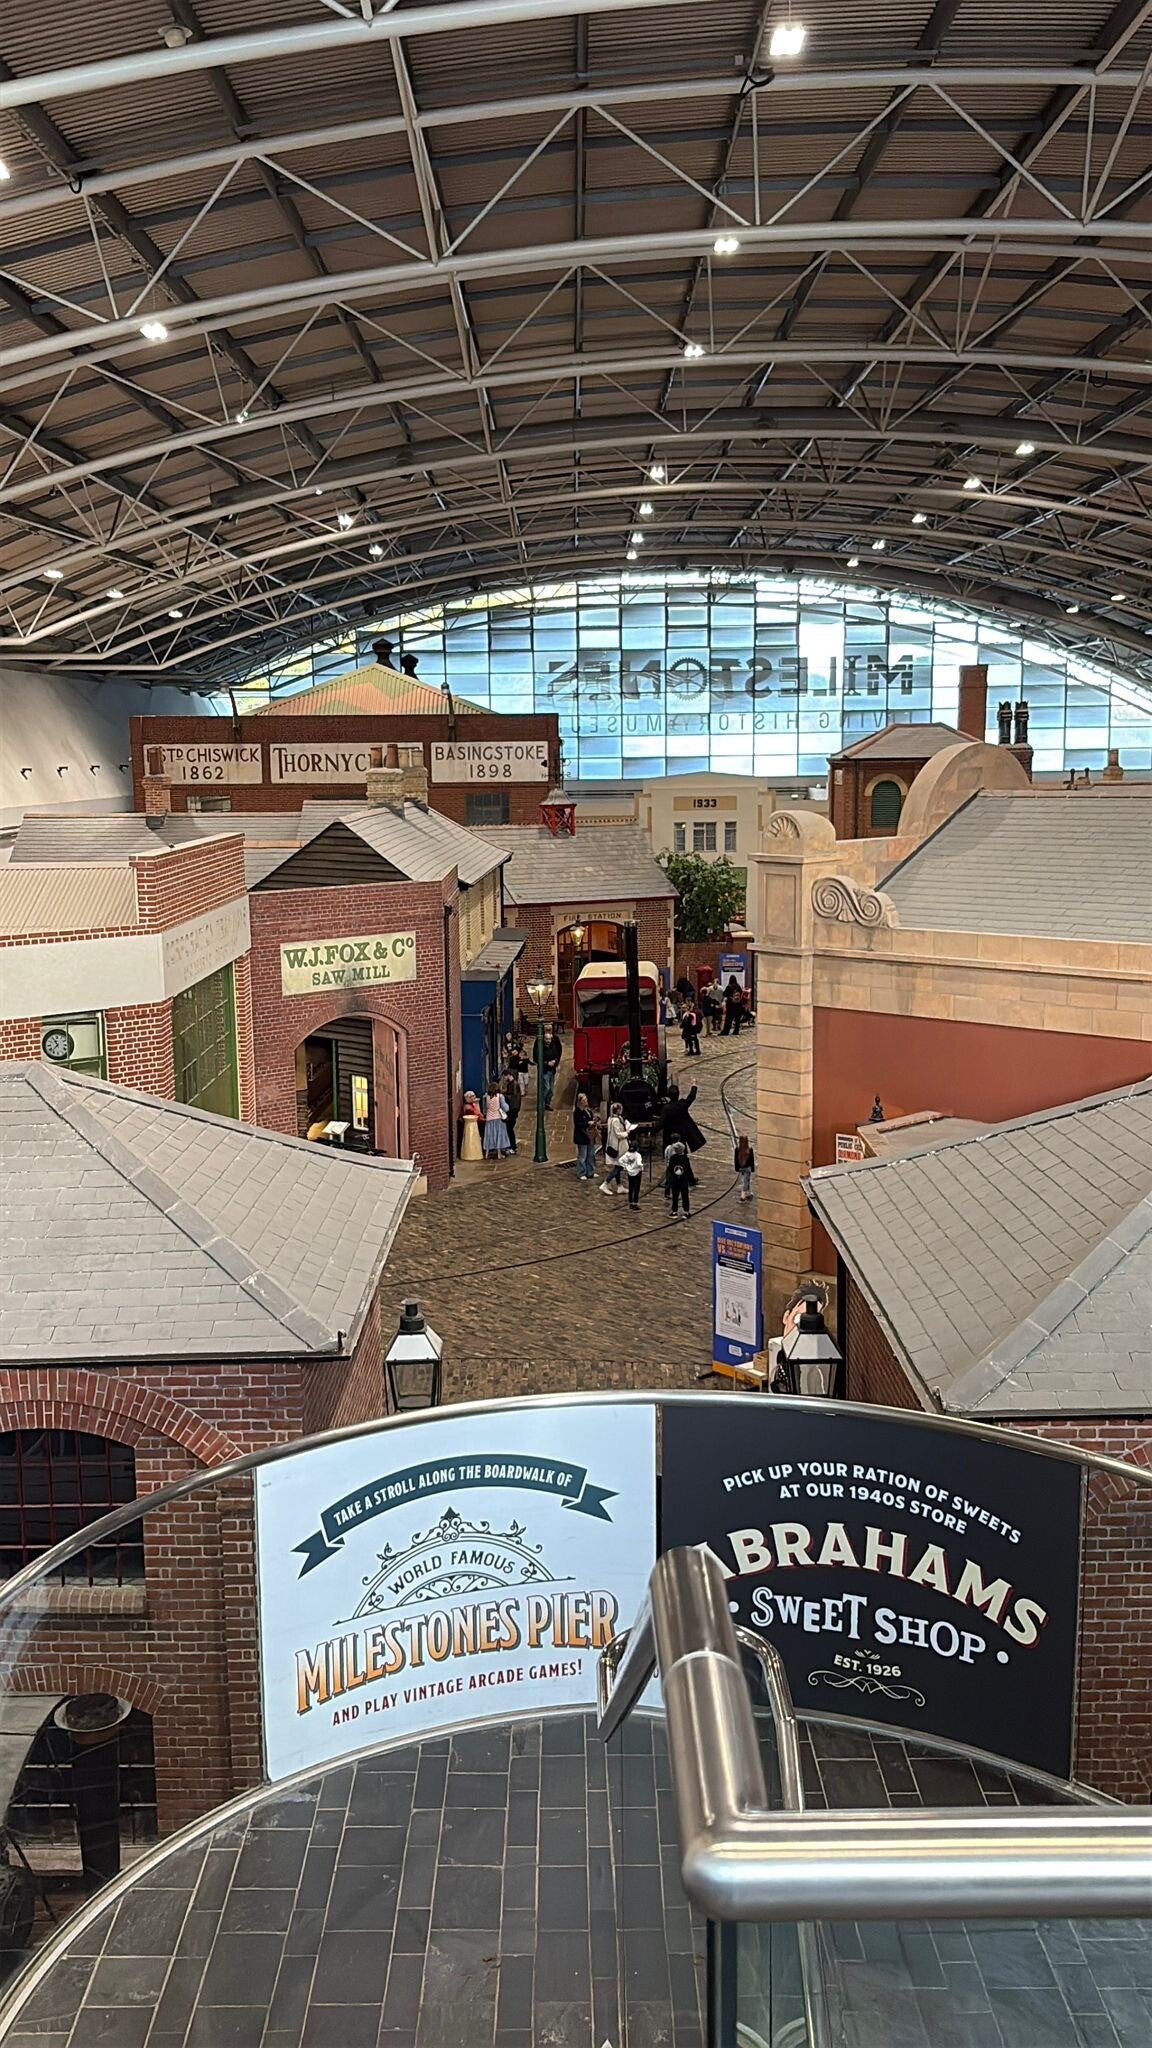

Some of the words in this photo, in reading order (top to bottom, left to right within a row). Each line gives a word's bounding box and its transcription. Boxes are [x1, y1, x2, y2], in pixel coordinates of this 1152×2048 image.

[186, 747, 260, 763] CHISWICK
[272, 746, 420, 780] THORNYC
[435, 745, 545, 761] BASINGSTOKE
[182, 766, 225, 780] 1862
[469, 764, 512, 778] 1898
[693, 798, 717, 809] 1933
[587, 912, 621, 920] STATION
[283, 942, 371, 969] W.J.FOX
[373, 941, 388, 960] &
[312, 969, 346, 986] SAW
[352, 965, 391, 981] MILL
[333, 1505, 363, 1526] TAKE
[363, 1495, 374, 1510] A
[374, 1471, 417, 1503] STROLL
[418, 1467, 456, 1489] ALONG
[459, 1465, 482, 1479] THE
[484, 1464, 555, 1484] BOARDWALK
[557, 1473, 573, 1487] OF
[723, 1468, 766, 1492] PICK
[768, 1464, 794, 1480] UP
[797, 1462, 848, 1478] YOUR
[853, 1465, 921, 1494] RATION
[925, 1484, 949, 1502] OF
[952, 1496, 1022, 1544] SWEETS
[779, 1484, 801, 1500] AT
[806, 1483, 844, 1498] OUR
[849, 1486, 906, 1510] 1940S
[909, 1500, 968, 1535] STORE
[387, 1554, 442, 1596] WORLD
[451, 1550, 516, 1575] FAMOUS
[751, 1586, 867, 1640] SWEET
[874, 1607, 986, 1664] SHOP
[295, 1598, 521, 1715] MILESTONES
[526, 1590, 619, 1650] PIER
[833, 1654, 863, 1673] EST.
[866, 1663, 902, 1678] 1926
[332, 1705, 360, 1726] AND
[364, 1693, 398, 1715] PLAY
[403, 1677, 464, 1704] VINTAGE
[469, 1668, 524, 1690] ARCADE
[528, 1658, 583, 1680] GAMES!
